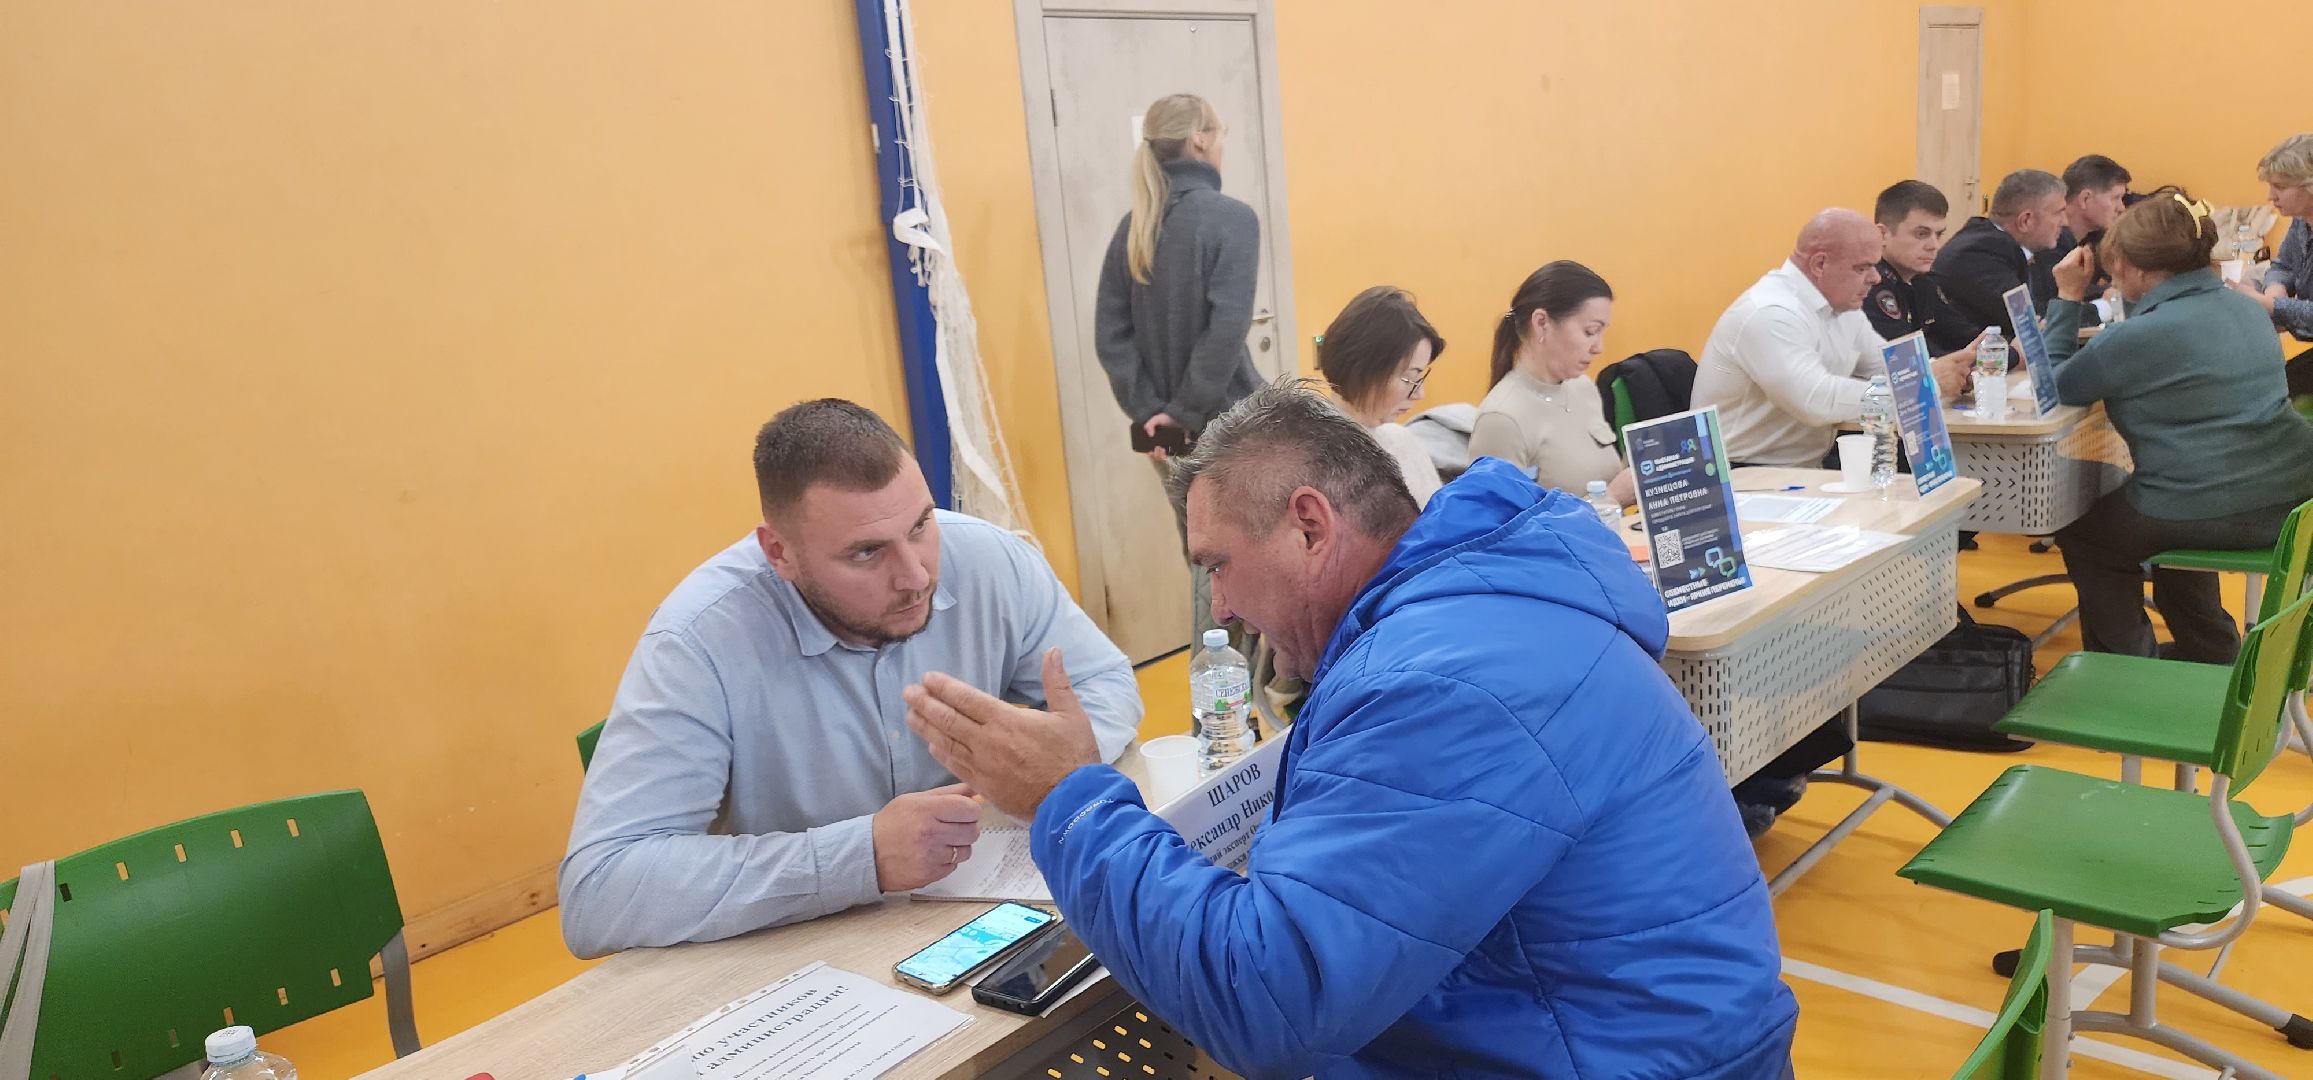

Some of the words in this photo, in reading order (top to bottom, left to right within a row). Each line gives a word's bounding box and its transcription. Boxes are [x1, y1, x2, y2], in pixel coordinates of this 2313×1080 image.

[1644, 479, 1689, 498] КУЗНЕЦОВА
[1648, 498, 1669, 511] АННА
[1669, 487, 1709, 505] ПЕТРОВНА
[1207, 763, 1261, 808] ШАРОВ
[1190, 813, 1241, 850] ександр
[1240, 789, 1274, 819] Нико
[706, 984, 849, 1070] администрации!
[716, 988, 818, 1048] участников
